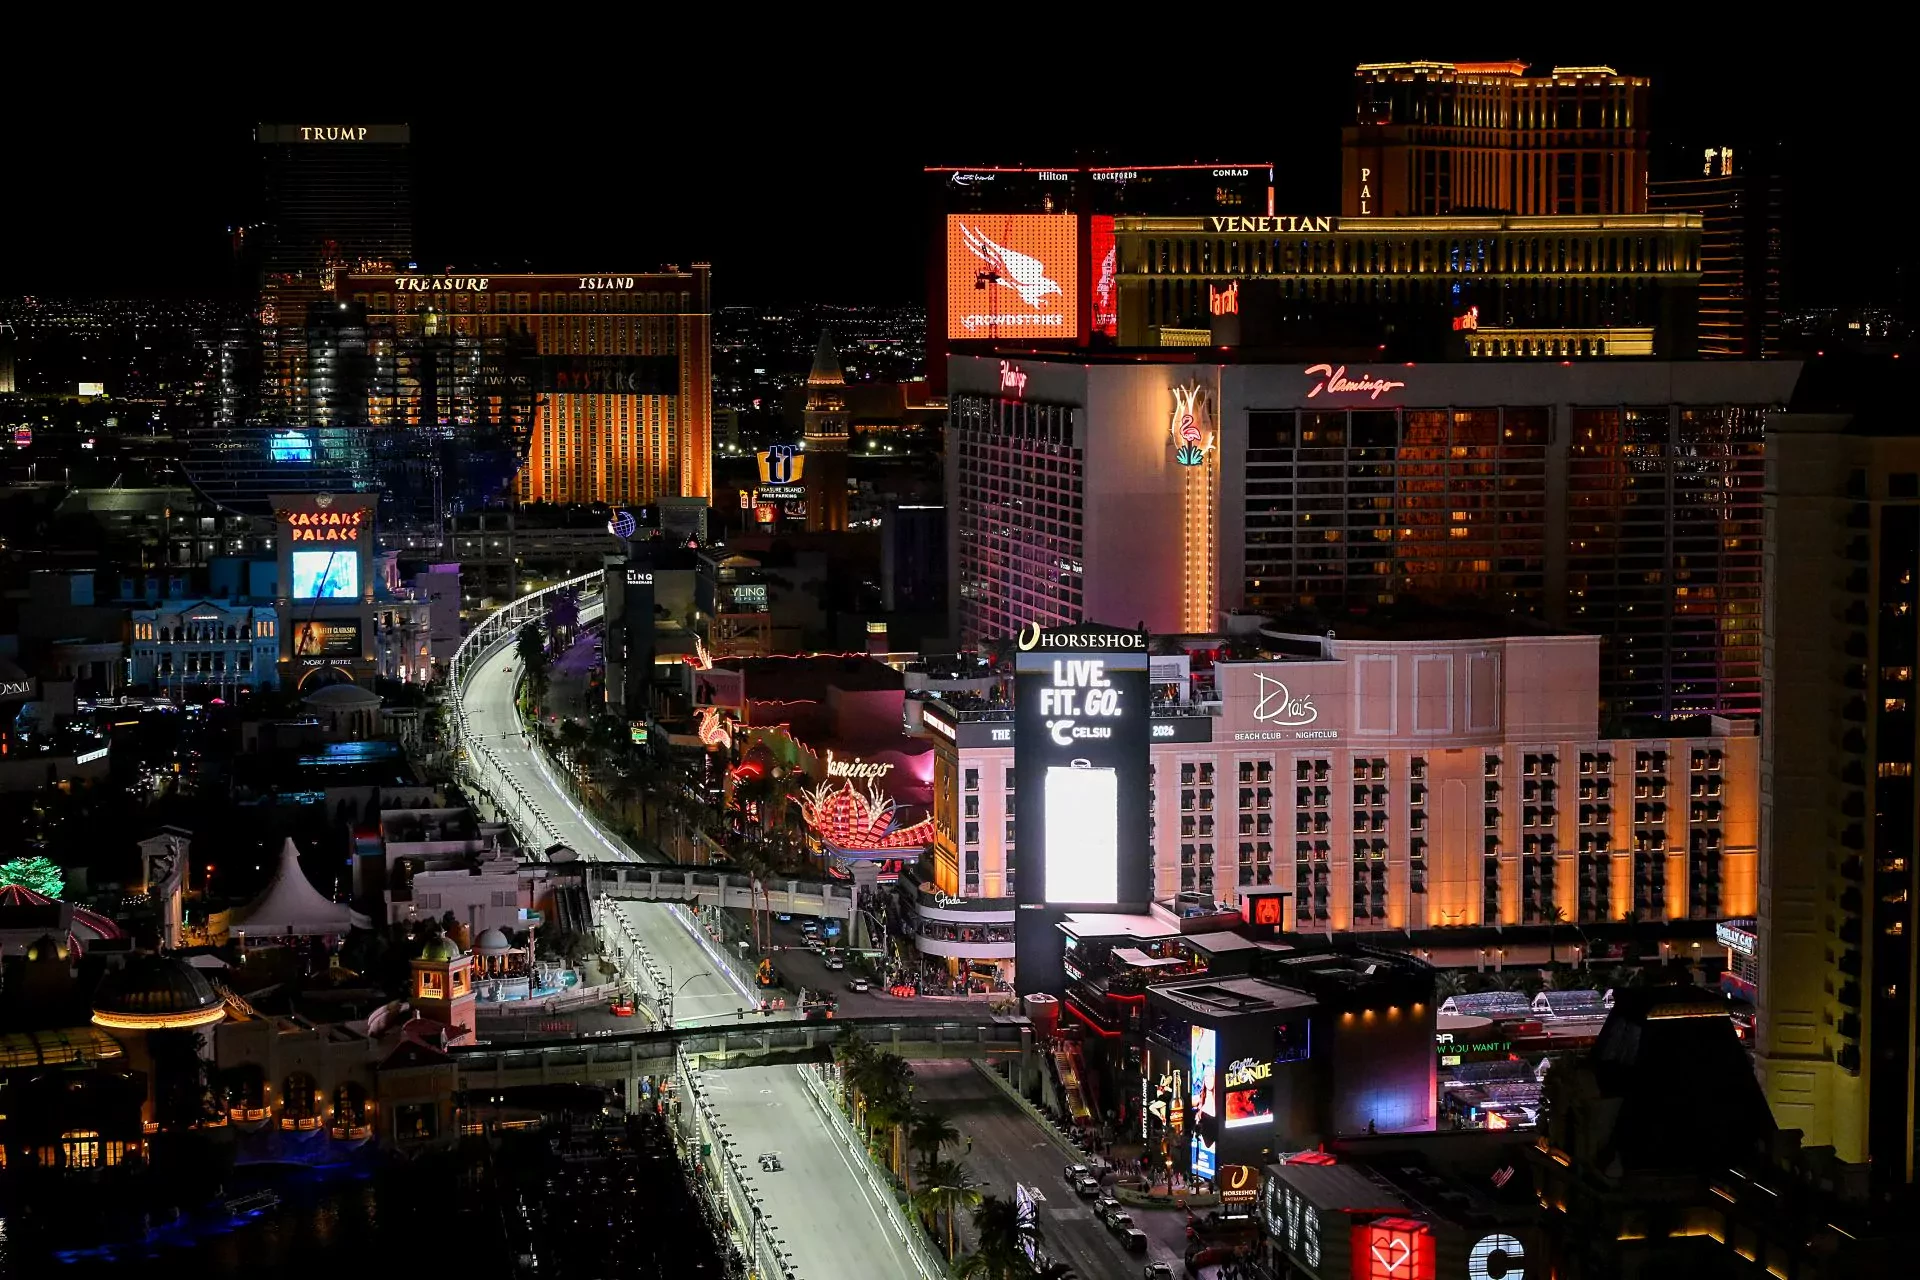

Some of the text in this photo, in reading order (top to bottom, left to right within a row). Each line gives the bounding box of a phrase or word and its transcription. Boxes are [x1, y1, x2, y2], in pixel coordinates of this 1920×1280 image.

[300, 127, 367, 141] TRUMP
[1038, 171, 1068, 181] Hilton
[1092, 171, 1138, 181] CROCKFORDS
[1212, 169, 1249, 177] CONRAD
[1210, 216, 1332, 232] VENETIAN
[395, 277, 634, 291] TREASURE ISLAND
[1304, 363, 1405, 400] Flamingo
[783, 486, 802, 494] ISLAND
[288, 513, 361, 526] CAESARS
[292, 528, 358, 541] PALACE
[627, 573, 653, 581] LINQ
[1053, 660, 1111, 687] LIVE.
[1040, 688, 1081, 716] FIT.
[991, 728, 1011, 741] THE
[1152, 726, 1175, 737] 2026
[1234, 730, 1338, 741] BEACH CLUB NIGHTCLUB
[1449, 1044, 1469, 1053] YOU
[1472, 1042, 1500, 1052] WANT
[1224, 1062, 1273, 1088] BLONDE
